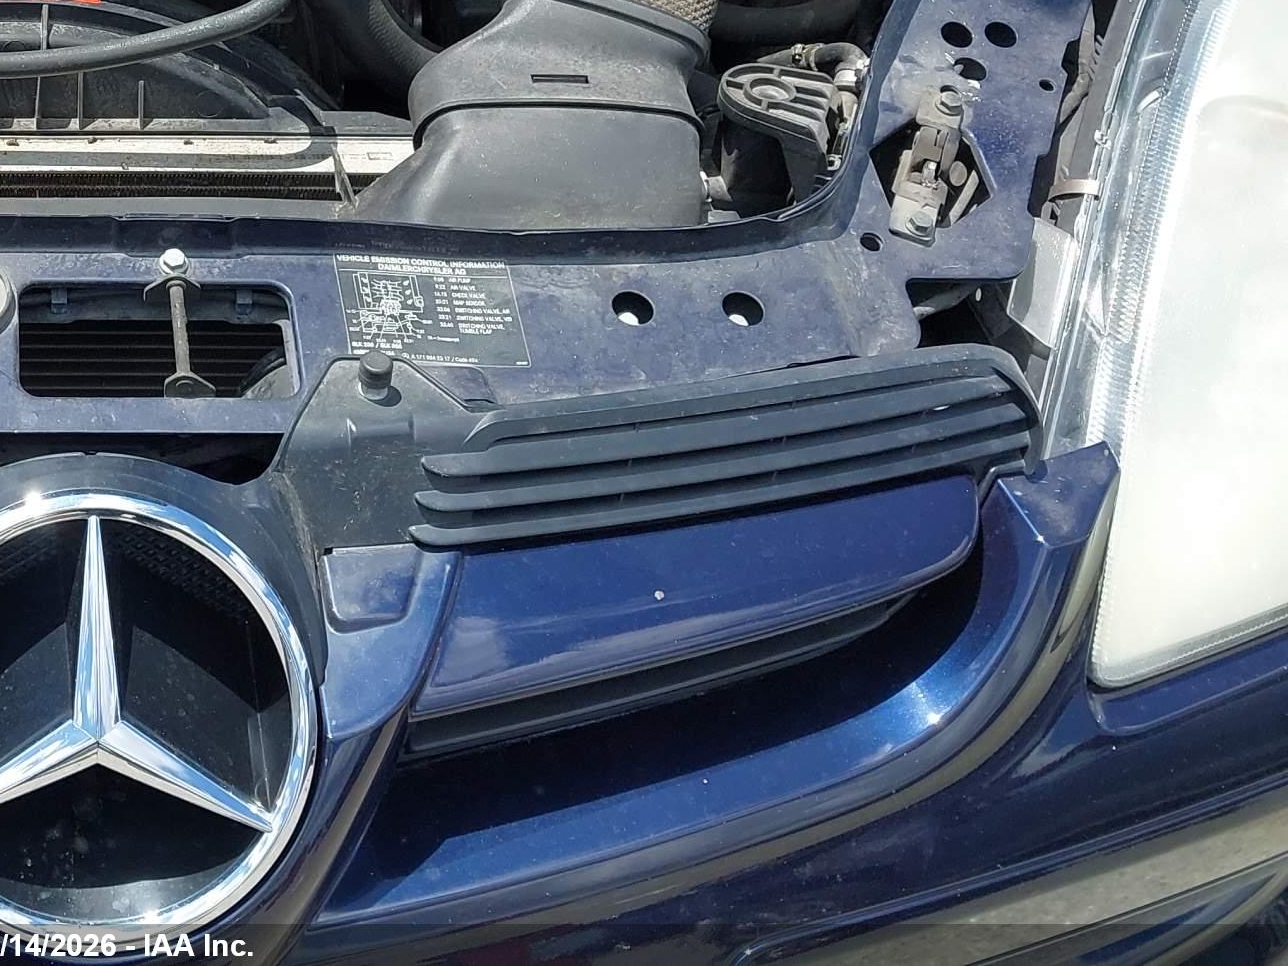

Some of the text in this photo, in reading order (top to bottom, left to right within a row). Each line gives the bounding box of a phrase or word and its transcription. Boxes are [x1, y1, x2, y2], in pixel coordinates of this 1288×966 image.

[336, 254, 505, 268] VEHICLE EMISSION CONTROL INFORMATION
[377, 263, 453, 275] DAIMLERCHRYSLER
